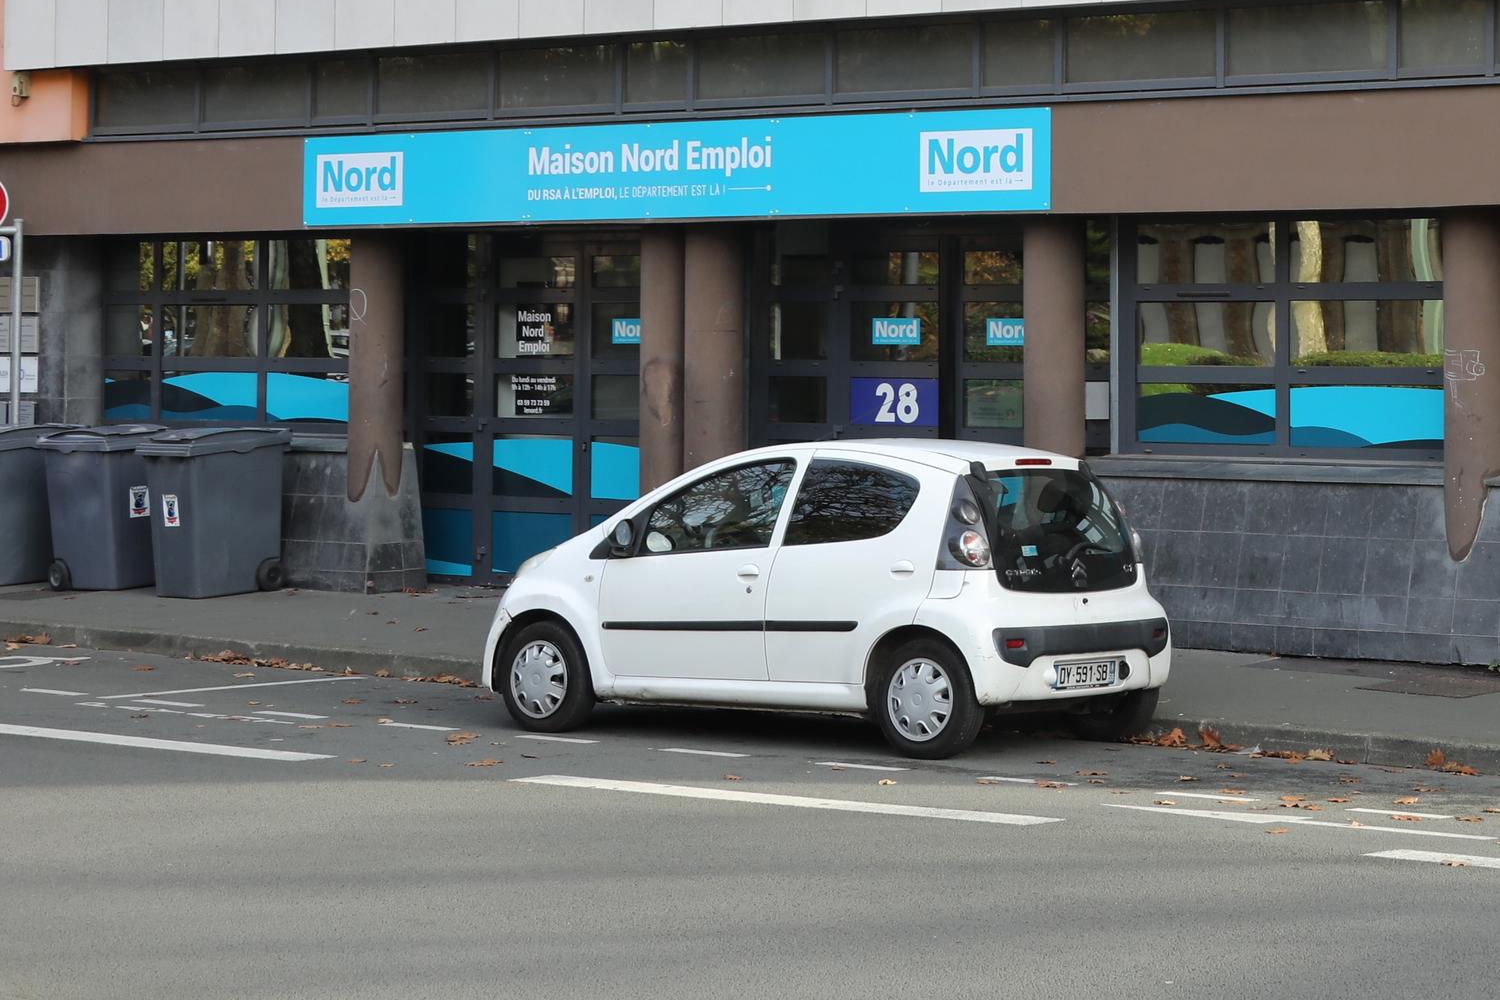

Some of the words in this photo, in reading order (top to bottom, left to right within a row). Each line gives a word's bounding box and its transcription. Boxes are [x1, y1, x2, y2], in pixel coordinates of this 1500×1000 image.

[528, 143, 613, 175] Maison
[621, 139, 679, 173] Nord
[686, 136, 772, 177] Emploi
[928, 133, 1023, 174] Nord
[322, 156, 397, 193] Nord
[528, 189, 540, 200] DU
[543, 188, 562, 200] RSA
[563, 185, 570, 199] À
[572, 186, 618, 200] L'EMPLOI,
[619, 187, 629, 198] LE
[632, 184, 688, 199] DÉPARTEMENT
[691, 184, 706, 196] EST
[709, 182, 720, 196] LÀ
[518, 310, 551, 323] Maison
[522, 325, 544, 338] Nord
[614, 321, 640, 337] Nor
[875, 320, 917, 338] Nord
[989, 321, 1024, 338] Nor
[518, 340, 550, 354] Emploi
[875, 383, 920, 424] 28
[1059, 663, 1108, 685] DY-591-SB
